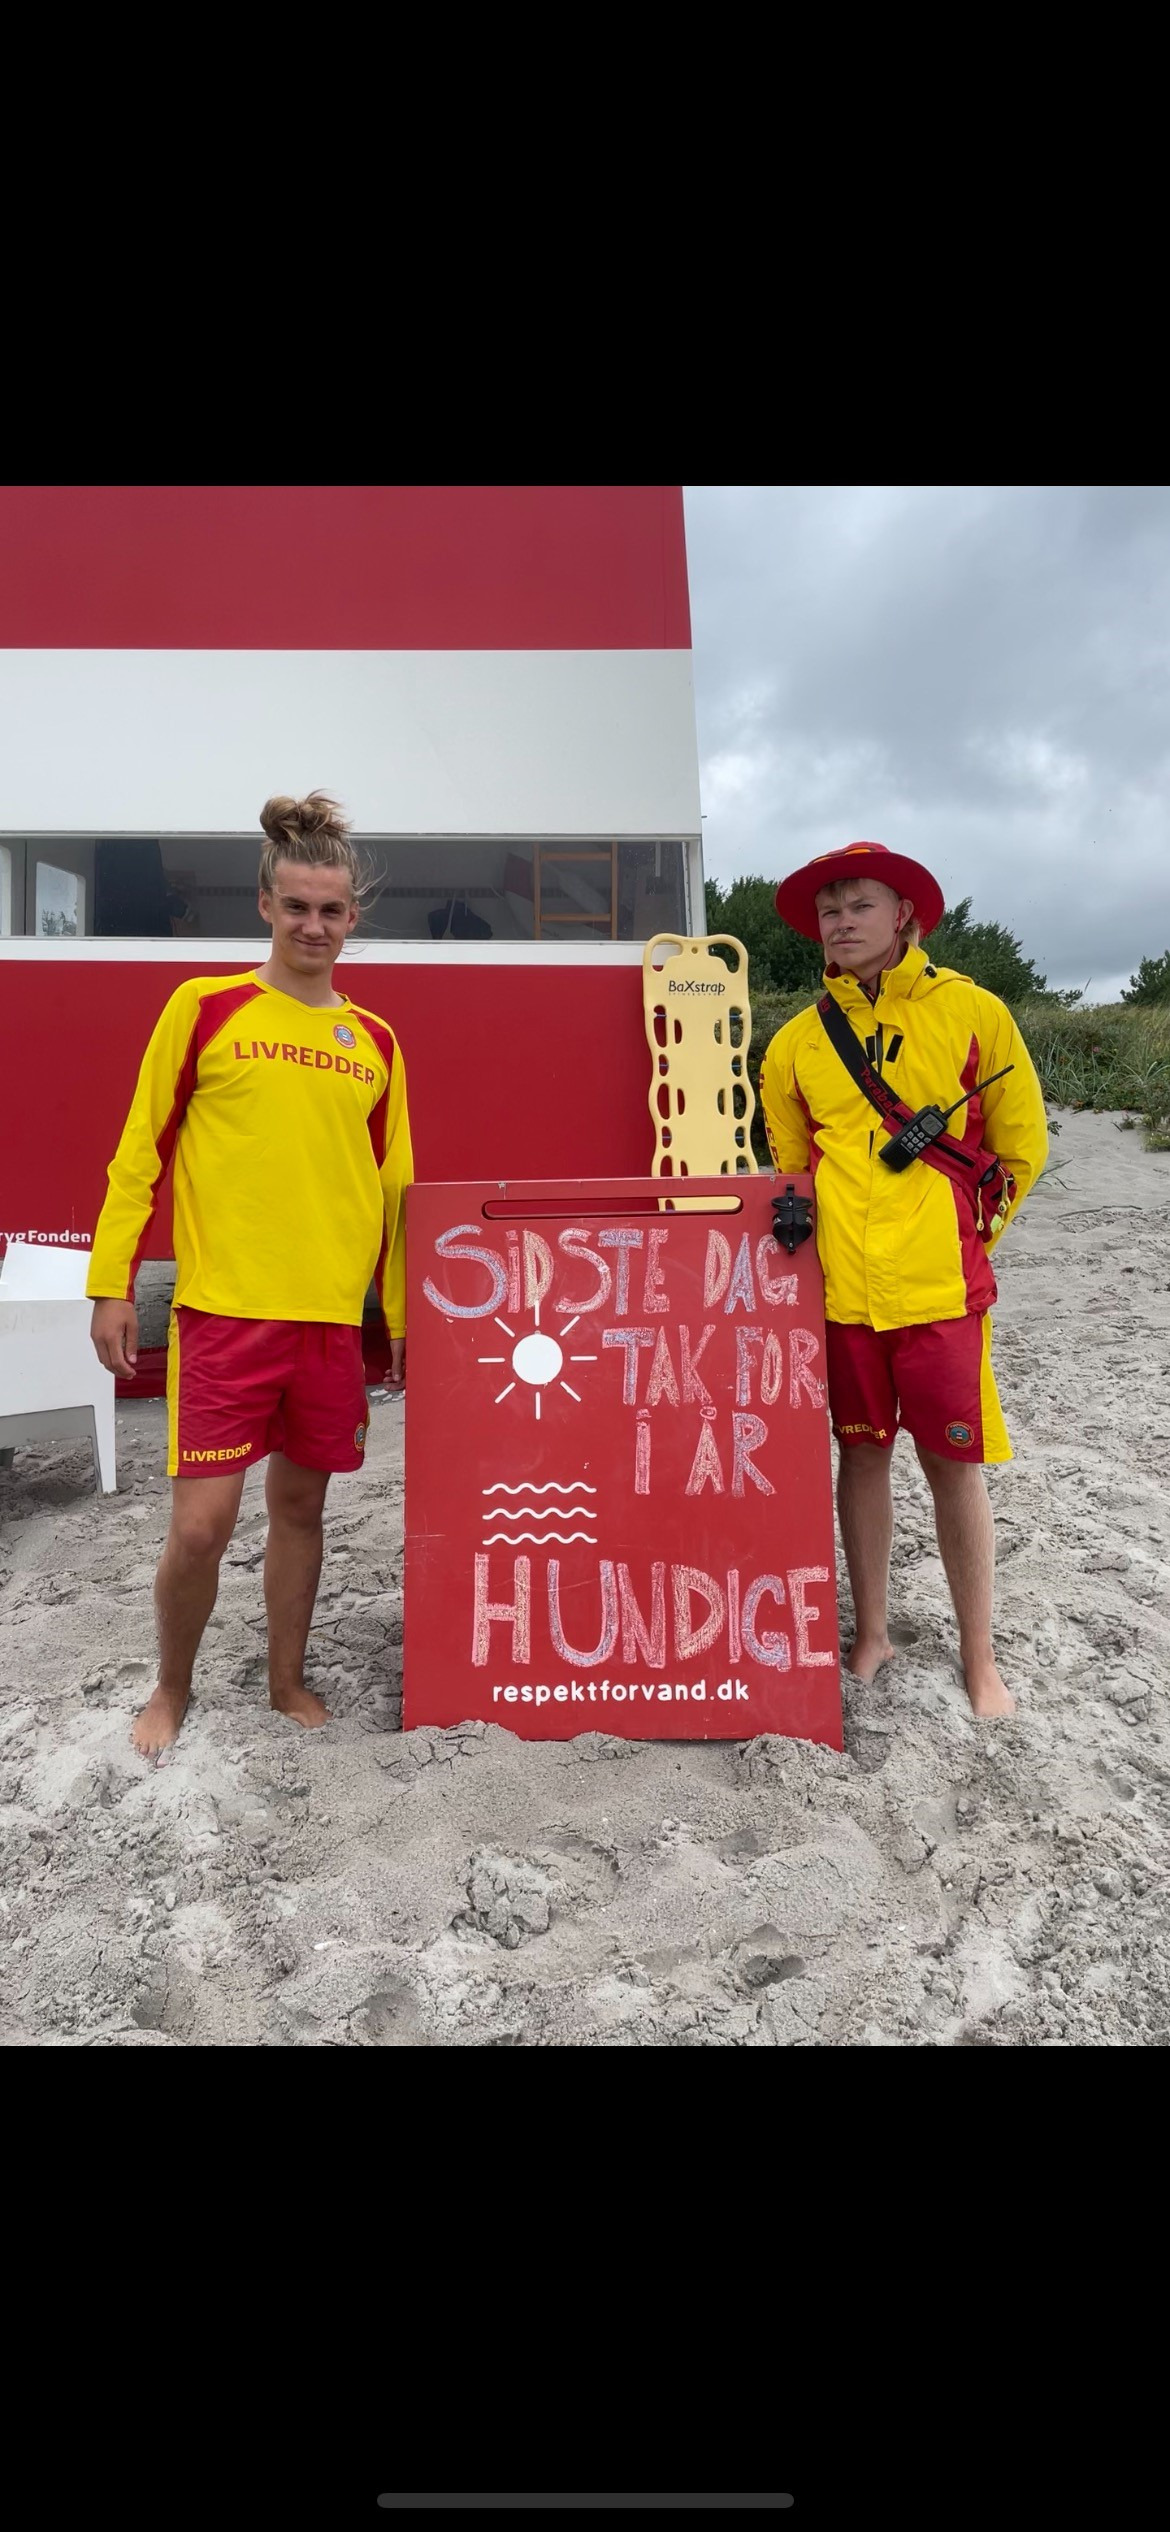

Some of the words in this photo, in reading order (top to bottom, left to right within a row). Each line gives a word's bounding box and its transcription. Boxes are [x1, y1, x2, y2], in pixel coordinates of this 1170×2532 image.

[668, 980, 726, 996] BaXstrap
[233, 1041, 375, 1088] LIVREDDER
[602, 1324, 716, 1407] TAK
[735, 1325, 826, 1409] FOR
[182, 1442, 253, 1462] LIVREDDER
[684, 1405, 778, 1498] ÅR
[472, 1552, 836, 1672] HUNDIGE
[492, 1679, 750, 1707] respektforvand.dk
